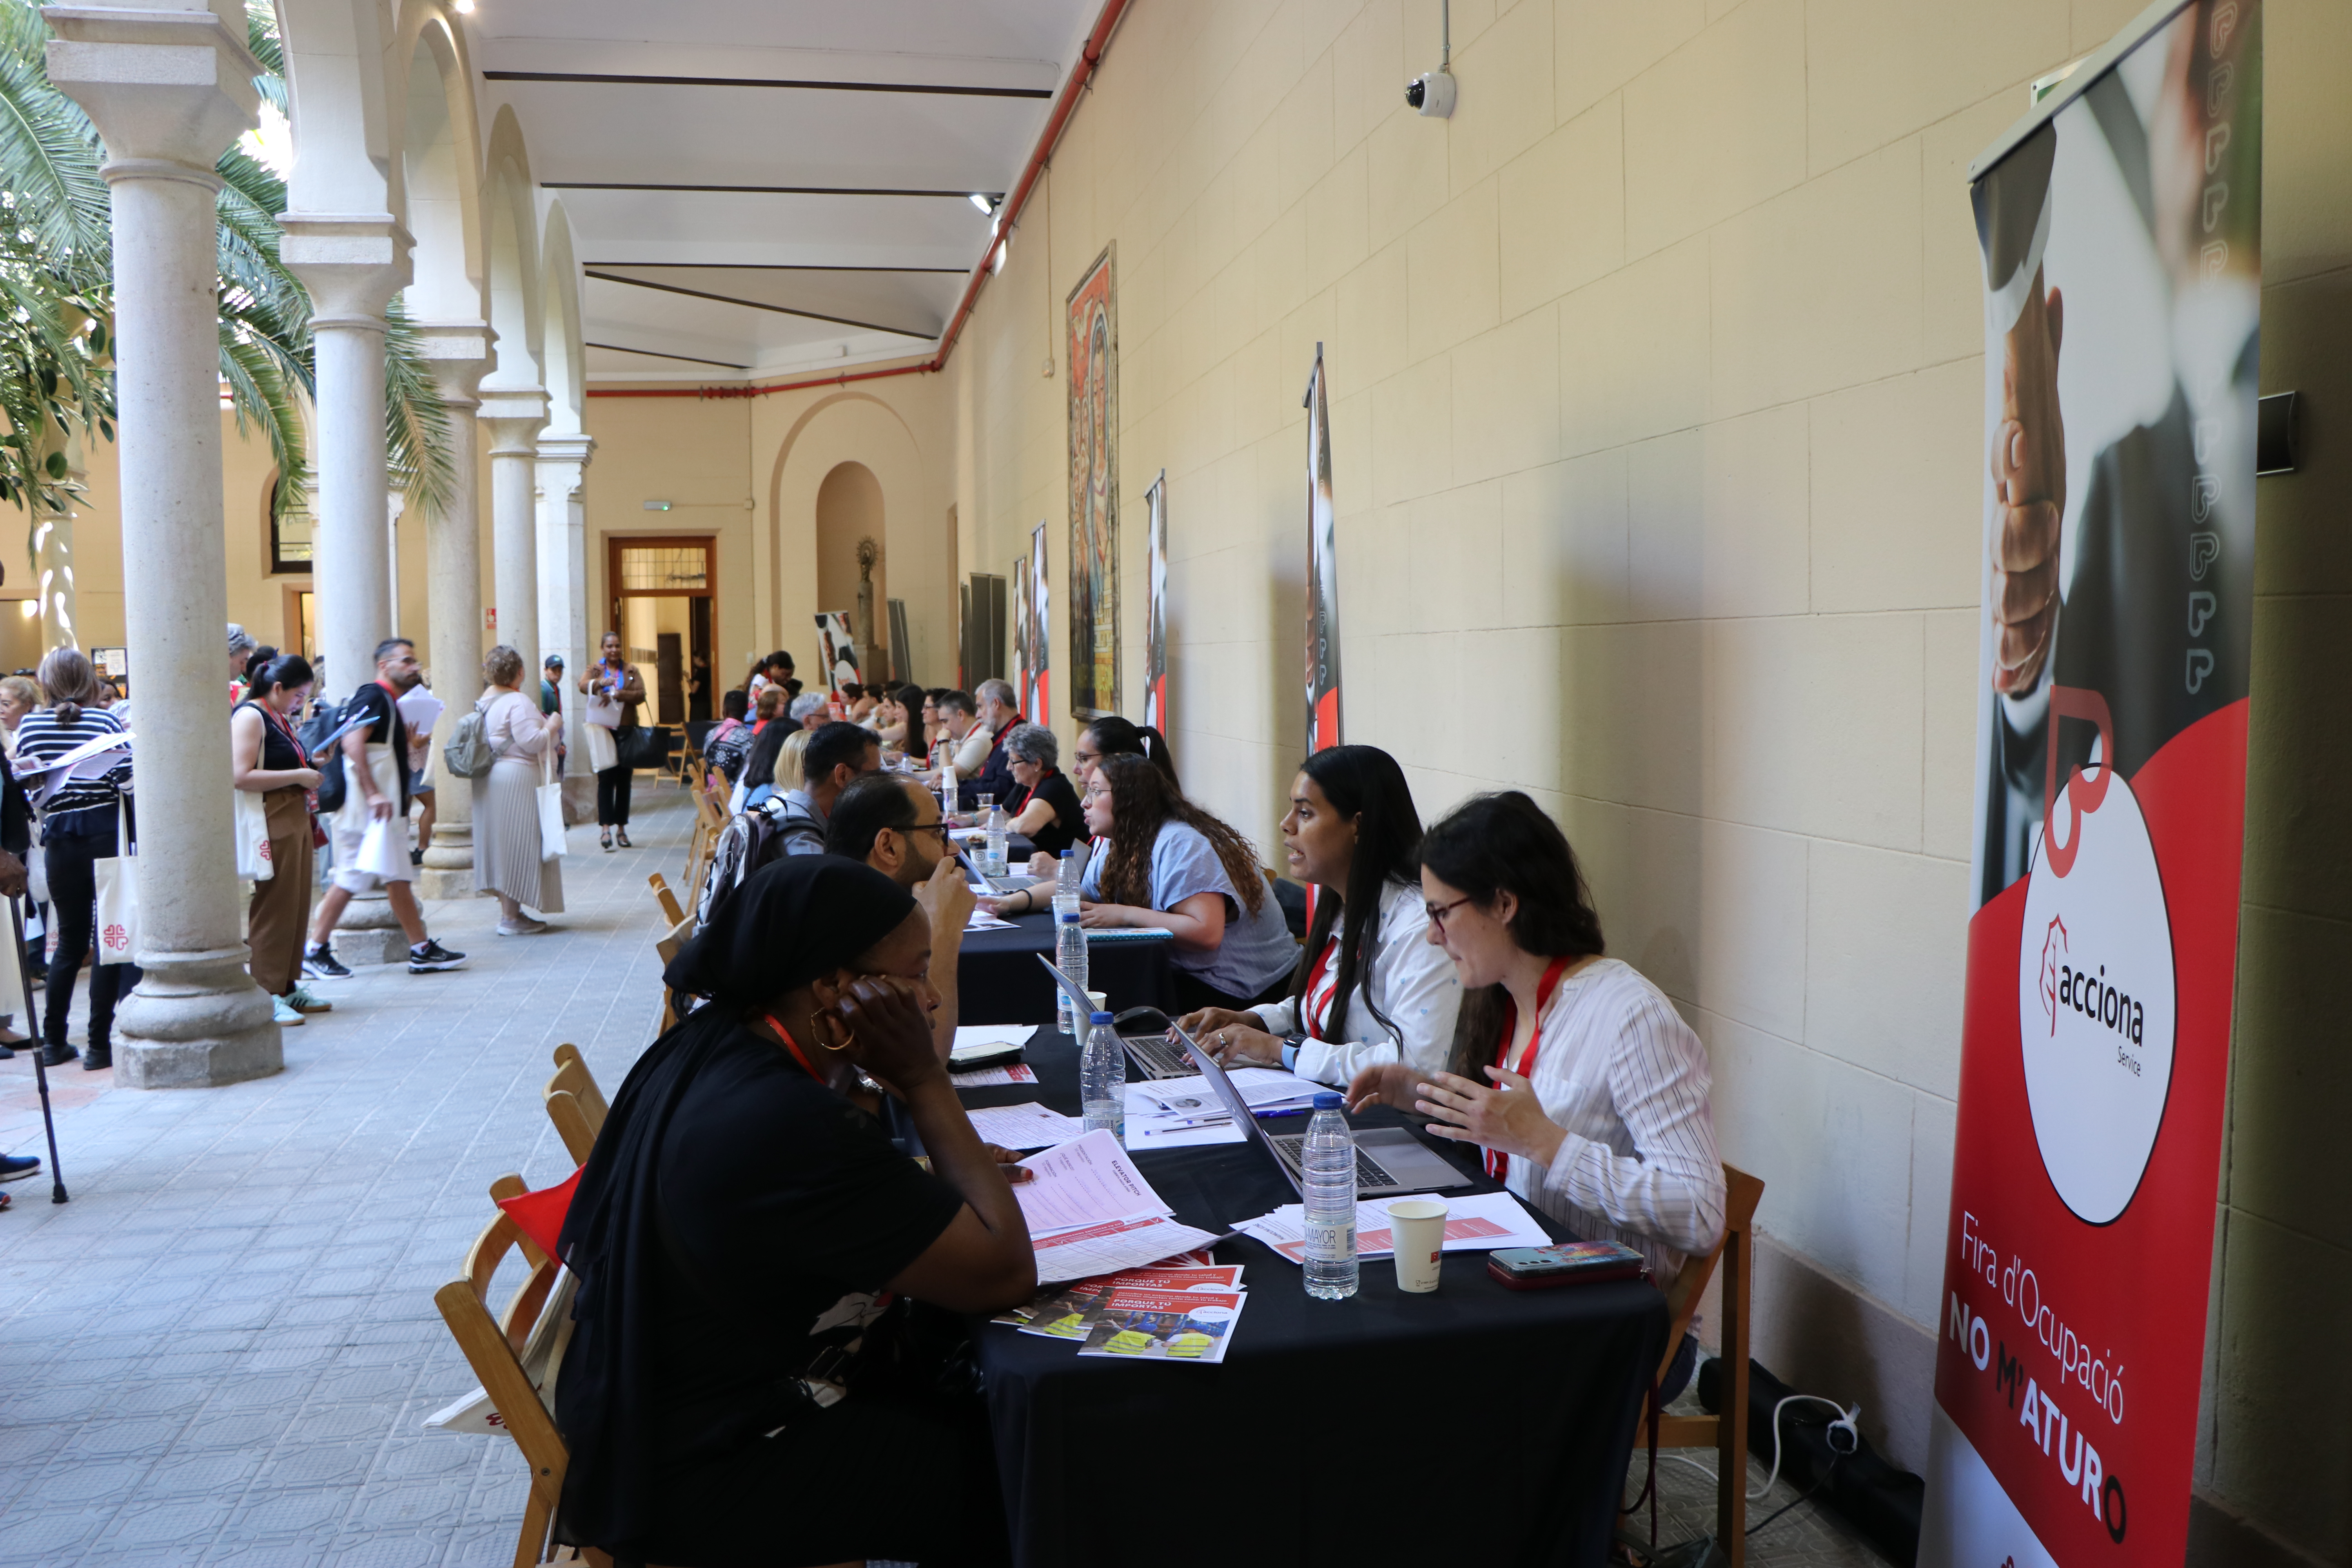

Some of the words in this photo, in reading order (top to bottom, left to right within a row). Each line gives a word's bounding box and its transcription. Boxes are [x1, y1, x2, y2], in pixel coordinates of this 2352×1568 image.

[2060, 965, 2143, 1047] acciona
[2118, 1046, 2141, 1076] Service
[1045, 1159, 1057, 1178] FORMACIÓN
[1078, 1144, 1093, 1165] PRESENTACIÓN
[1112, 1160, 1131, 1183] ELEVATOR
[1129, 1183, 1142, 1196] PITCH
[1949, 1290, 1990, 1371] NO
[1962, 1210, 1997, 1288] Fira
[2004, 1254, 2124, 1424] d'Ocupació
